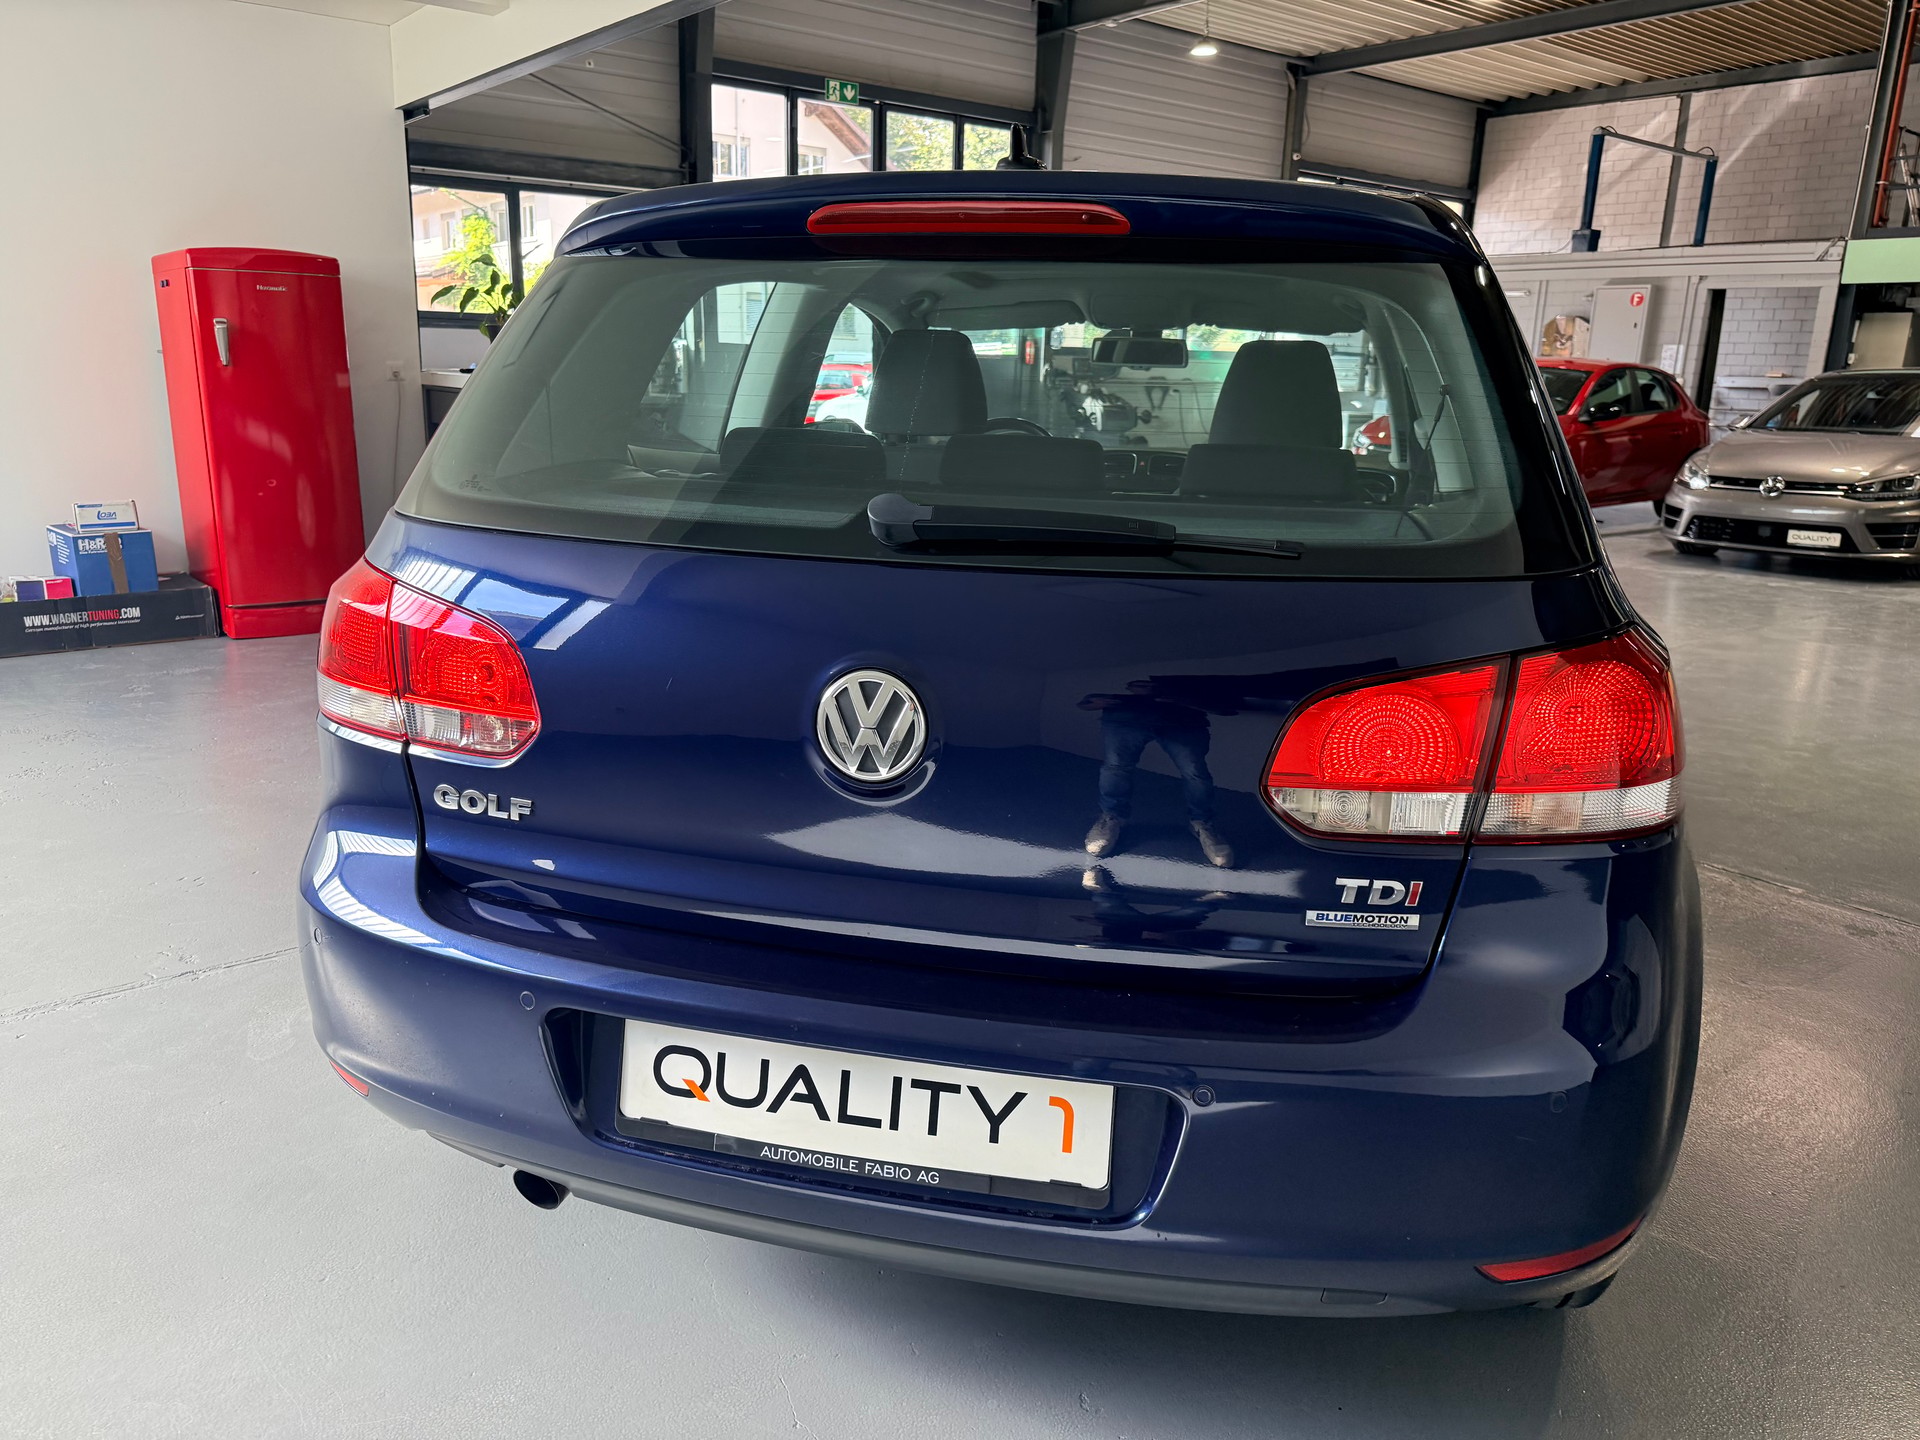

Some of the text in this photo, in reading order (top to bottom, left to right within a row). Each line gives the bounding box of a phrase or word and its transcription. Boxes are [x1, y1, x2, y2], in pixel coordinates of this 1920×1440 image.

[1632, 293, 1642, 306] F
[1791, 533, 1832, 543] QUALITY
[23, 607, 141, 627] WWW.WAGNERTUNING.COM
[433, 784, 532, 820] GOLF
[1335, 877, 1423, 906] TDI
[1315, 912, 1409, 924] BLUEMOTION
[652, 1044, 1029, 1144] QUALITY
[760, 1145, 940, 1184] AUTOMOBILE FABIO AG
